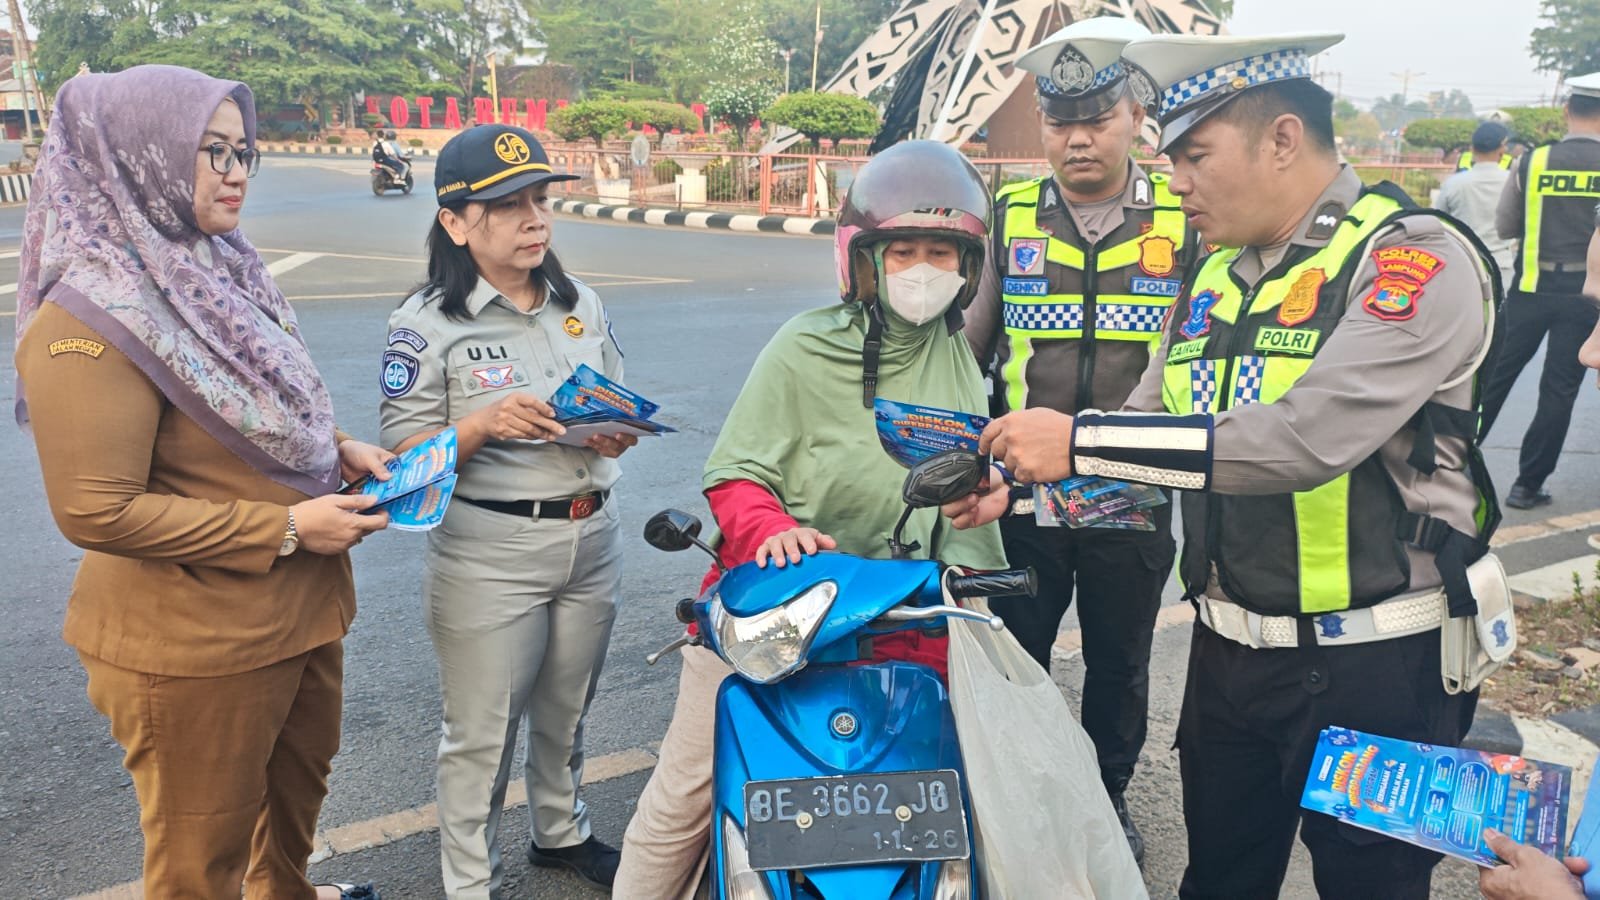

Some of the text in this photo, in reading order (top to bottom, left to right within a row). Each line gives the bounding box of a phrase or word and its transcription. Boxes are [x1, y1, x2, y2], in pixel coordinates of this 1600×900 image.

[1007, 282, 1043, 293] DENKY
[1136, 282, 1176, 294] POLRI
[1260, 331, 1312, 349] POLRI
[467, 346, 508, 361] ULI
[907, 414, 966, 430] DISKON
[1331, 750, 1358, 793] DISKON
[750, 788, 798, 822] BE
[813, 783, 892, 817] 3662
